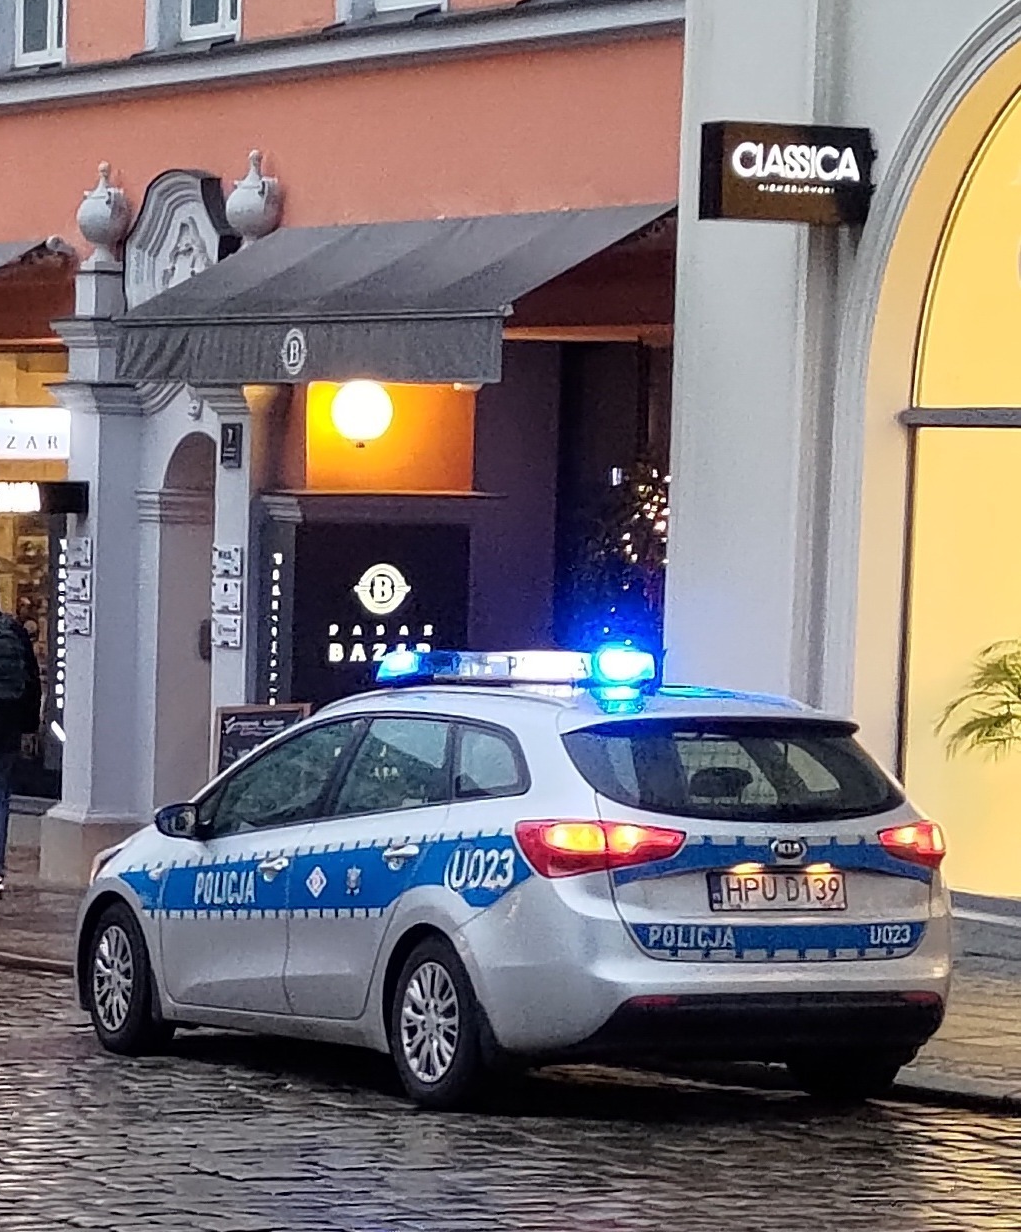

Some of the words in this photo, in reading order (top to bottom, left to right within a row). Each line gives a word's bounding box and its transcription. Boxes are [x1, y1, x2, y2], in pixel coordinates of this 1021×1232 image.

[732, 141, 860, 181] CLASSICA
[194, 870, 256, 905] POLICJA
[726, 877, 778, 902] HPU
[785, 877, 839, 902] D139
[648, 926, 736, 948] POLICJA
